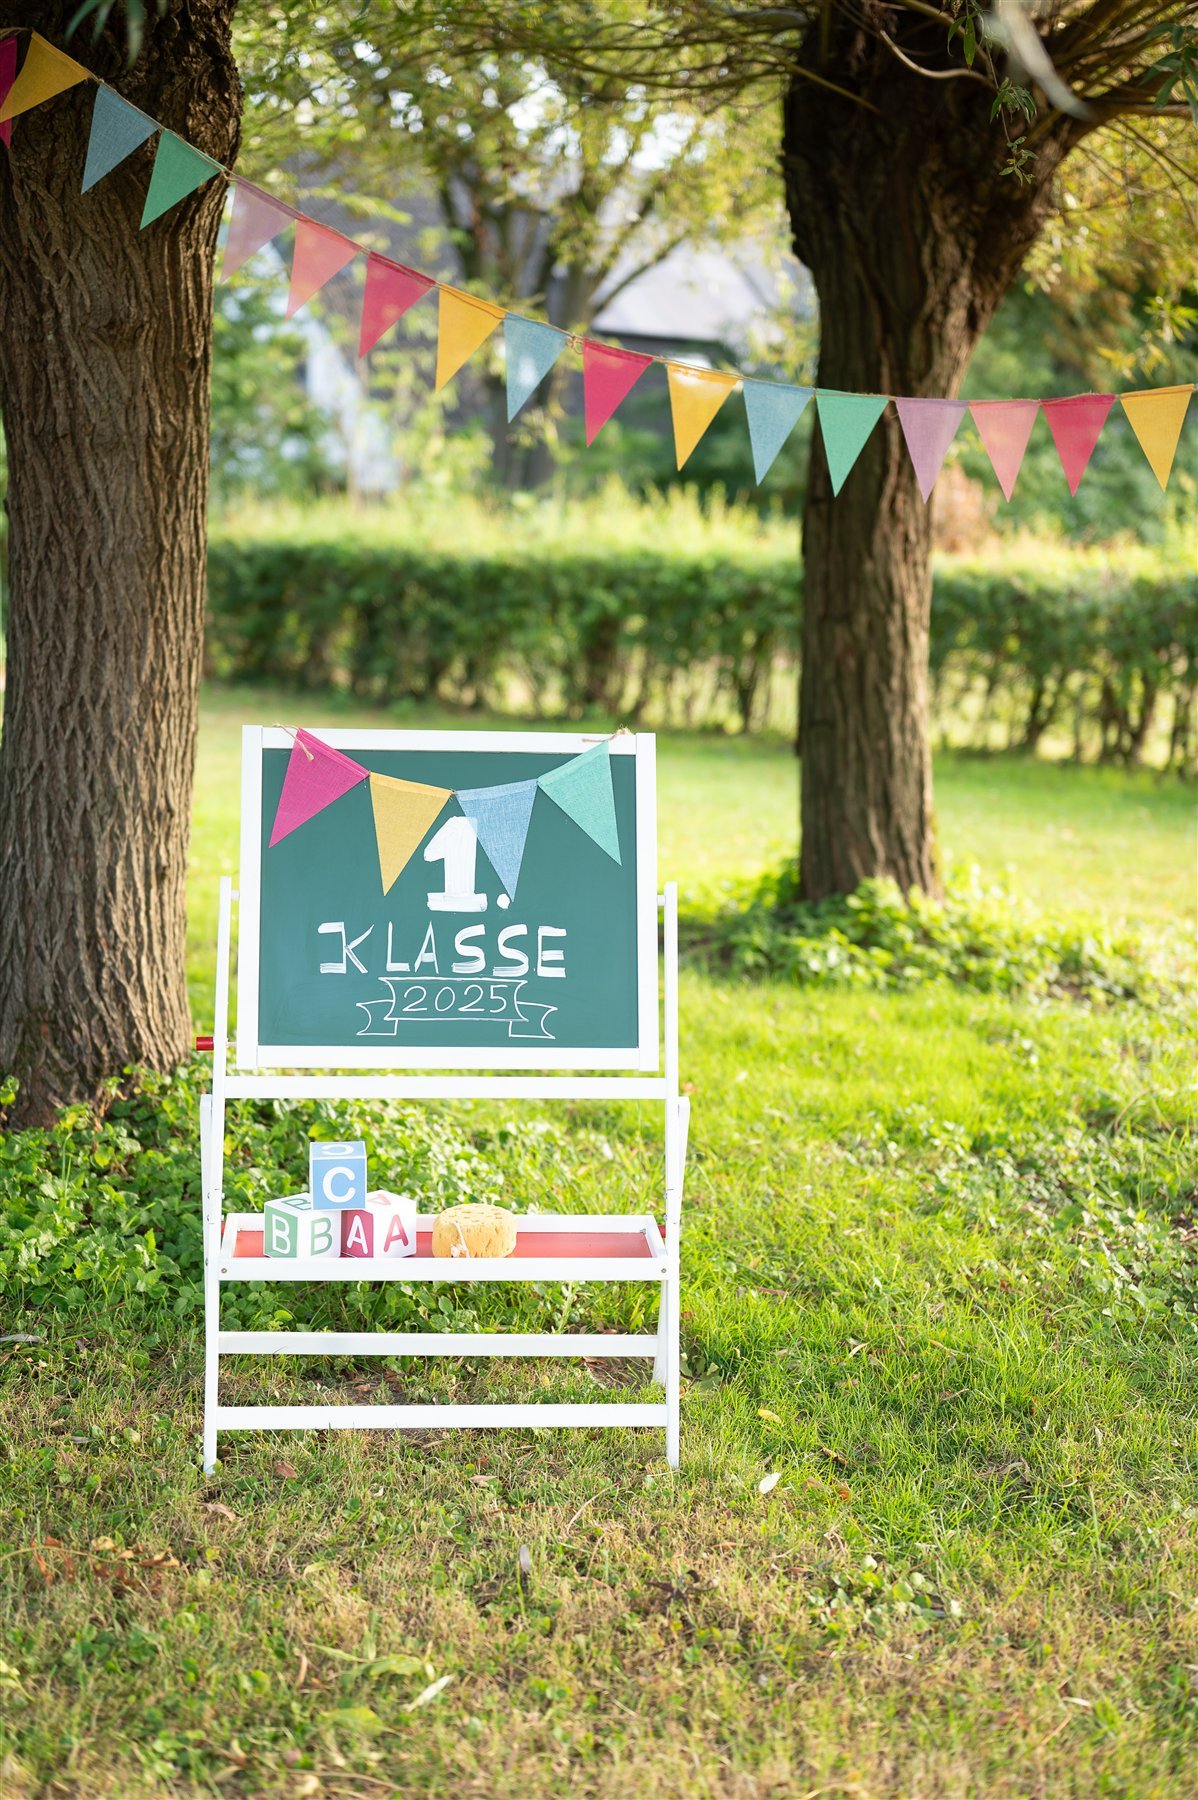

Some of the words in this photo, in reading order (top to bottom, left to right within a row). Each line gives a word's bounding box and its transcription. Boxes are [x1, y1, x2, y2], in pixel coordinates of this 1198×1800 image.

[424, 815, 511, 912] 1.
[317, 920, 567, 978] KLASSE
[402, 984, 508, 1013] 2025
[322, 1166, 356, 1203] C
[271, 1214, 291, 1254] B
[310, 1217, 333, 1256] B
[346, 1214, 369, 1255] A
[383, 1214, 409, 1253] A
